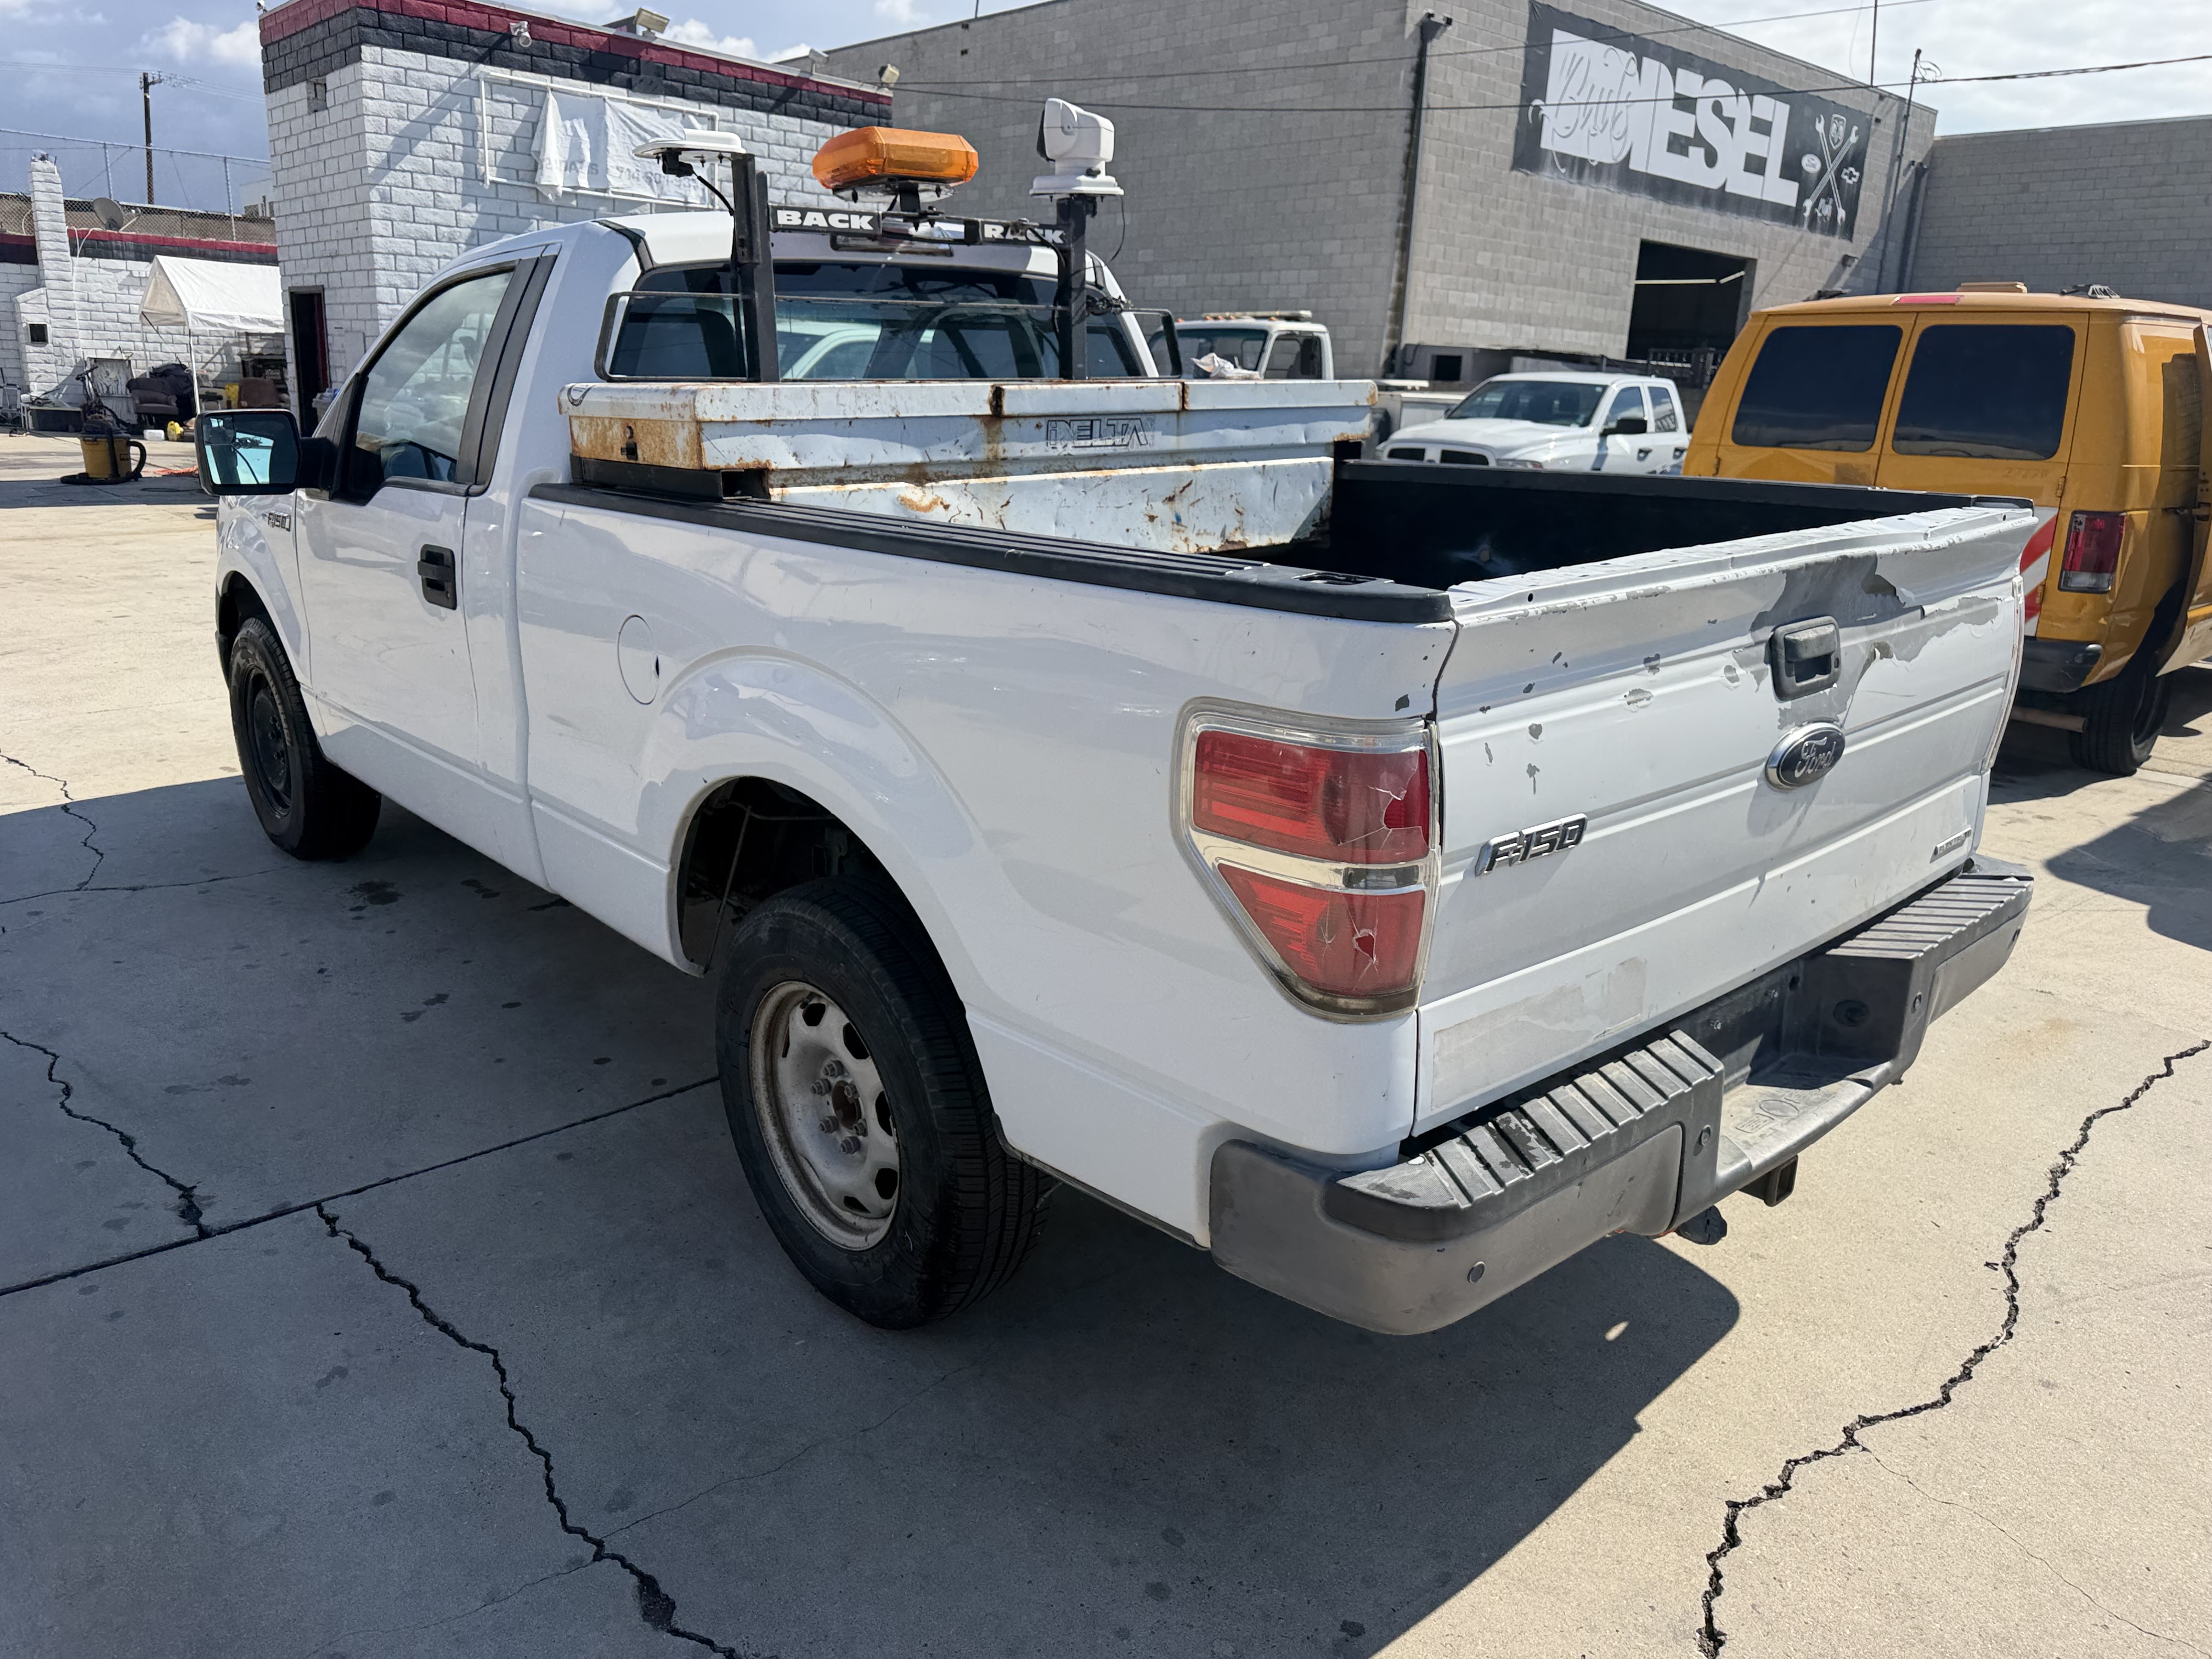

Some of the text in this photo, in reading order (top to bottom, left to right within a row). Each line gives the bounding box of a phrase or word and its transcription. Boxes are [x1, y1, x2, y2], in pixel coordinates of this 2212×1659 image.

[776, 210, 1064, 244] BACK RACK
[1046, 418, 1148, 448] DELTA
[1795, 736, 1837, 778] Ford
